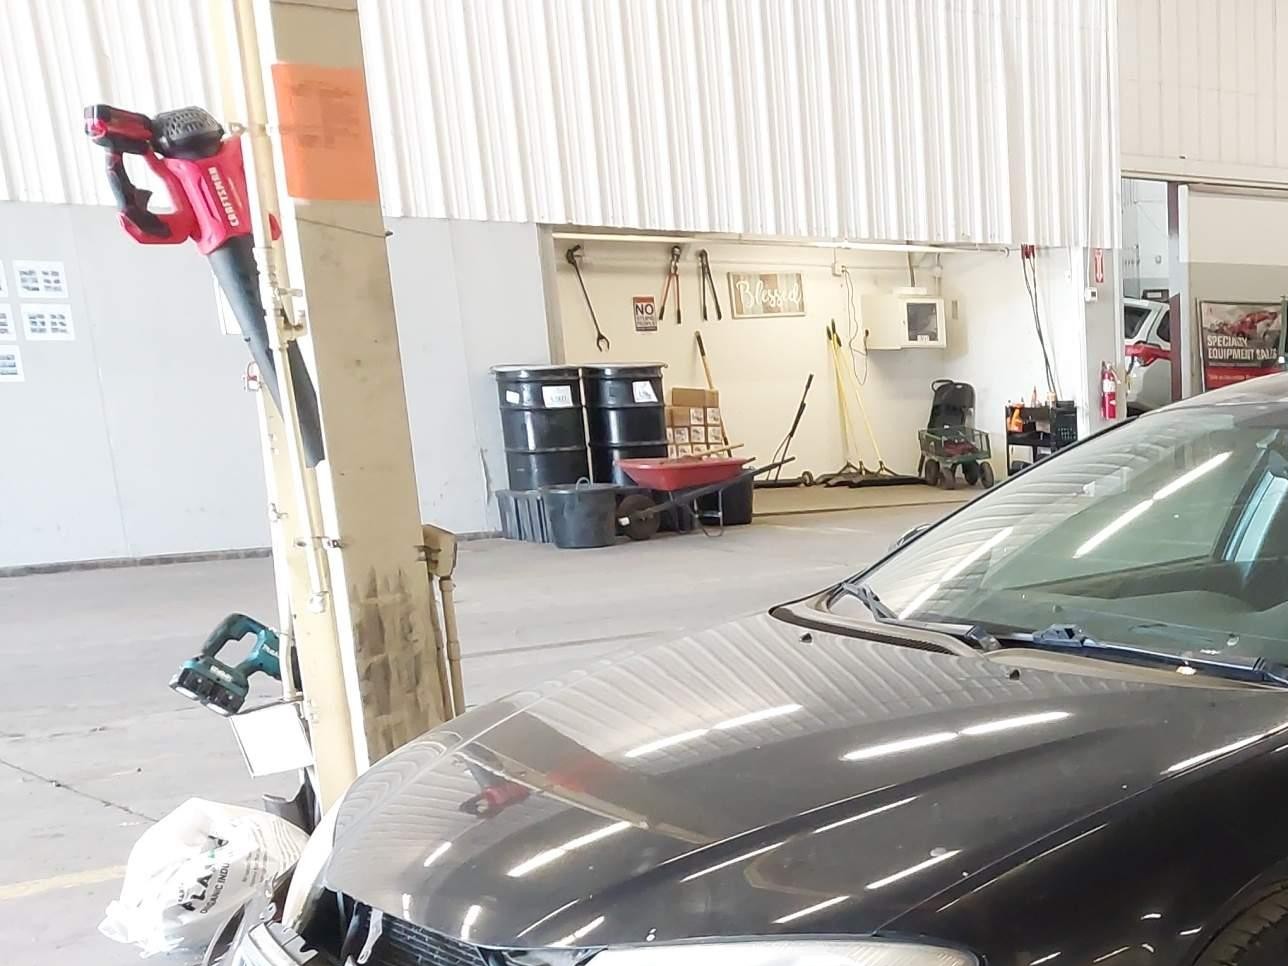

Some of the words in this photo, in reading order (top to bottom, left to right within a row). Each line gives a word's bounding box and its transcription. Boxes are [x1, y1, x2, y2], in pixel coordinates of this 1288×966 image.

[208, 166, 240, 227] CRAFTSMAN
[735, 279, 802, 308] Blessed
[635, 303, 654, 316] NO
[1207, 335, 1248, 348] SPECIALTY
[1208, 347, 1254, 361] EQUIPMENT
